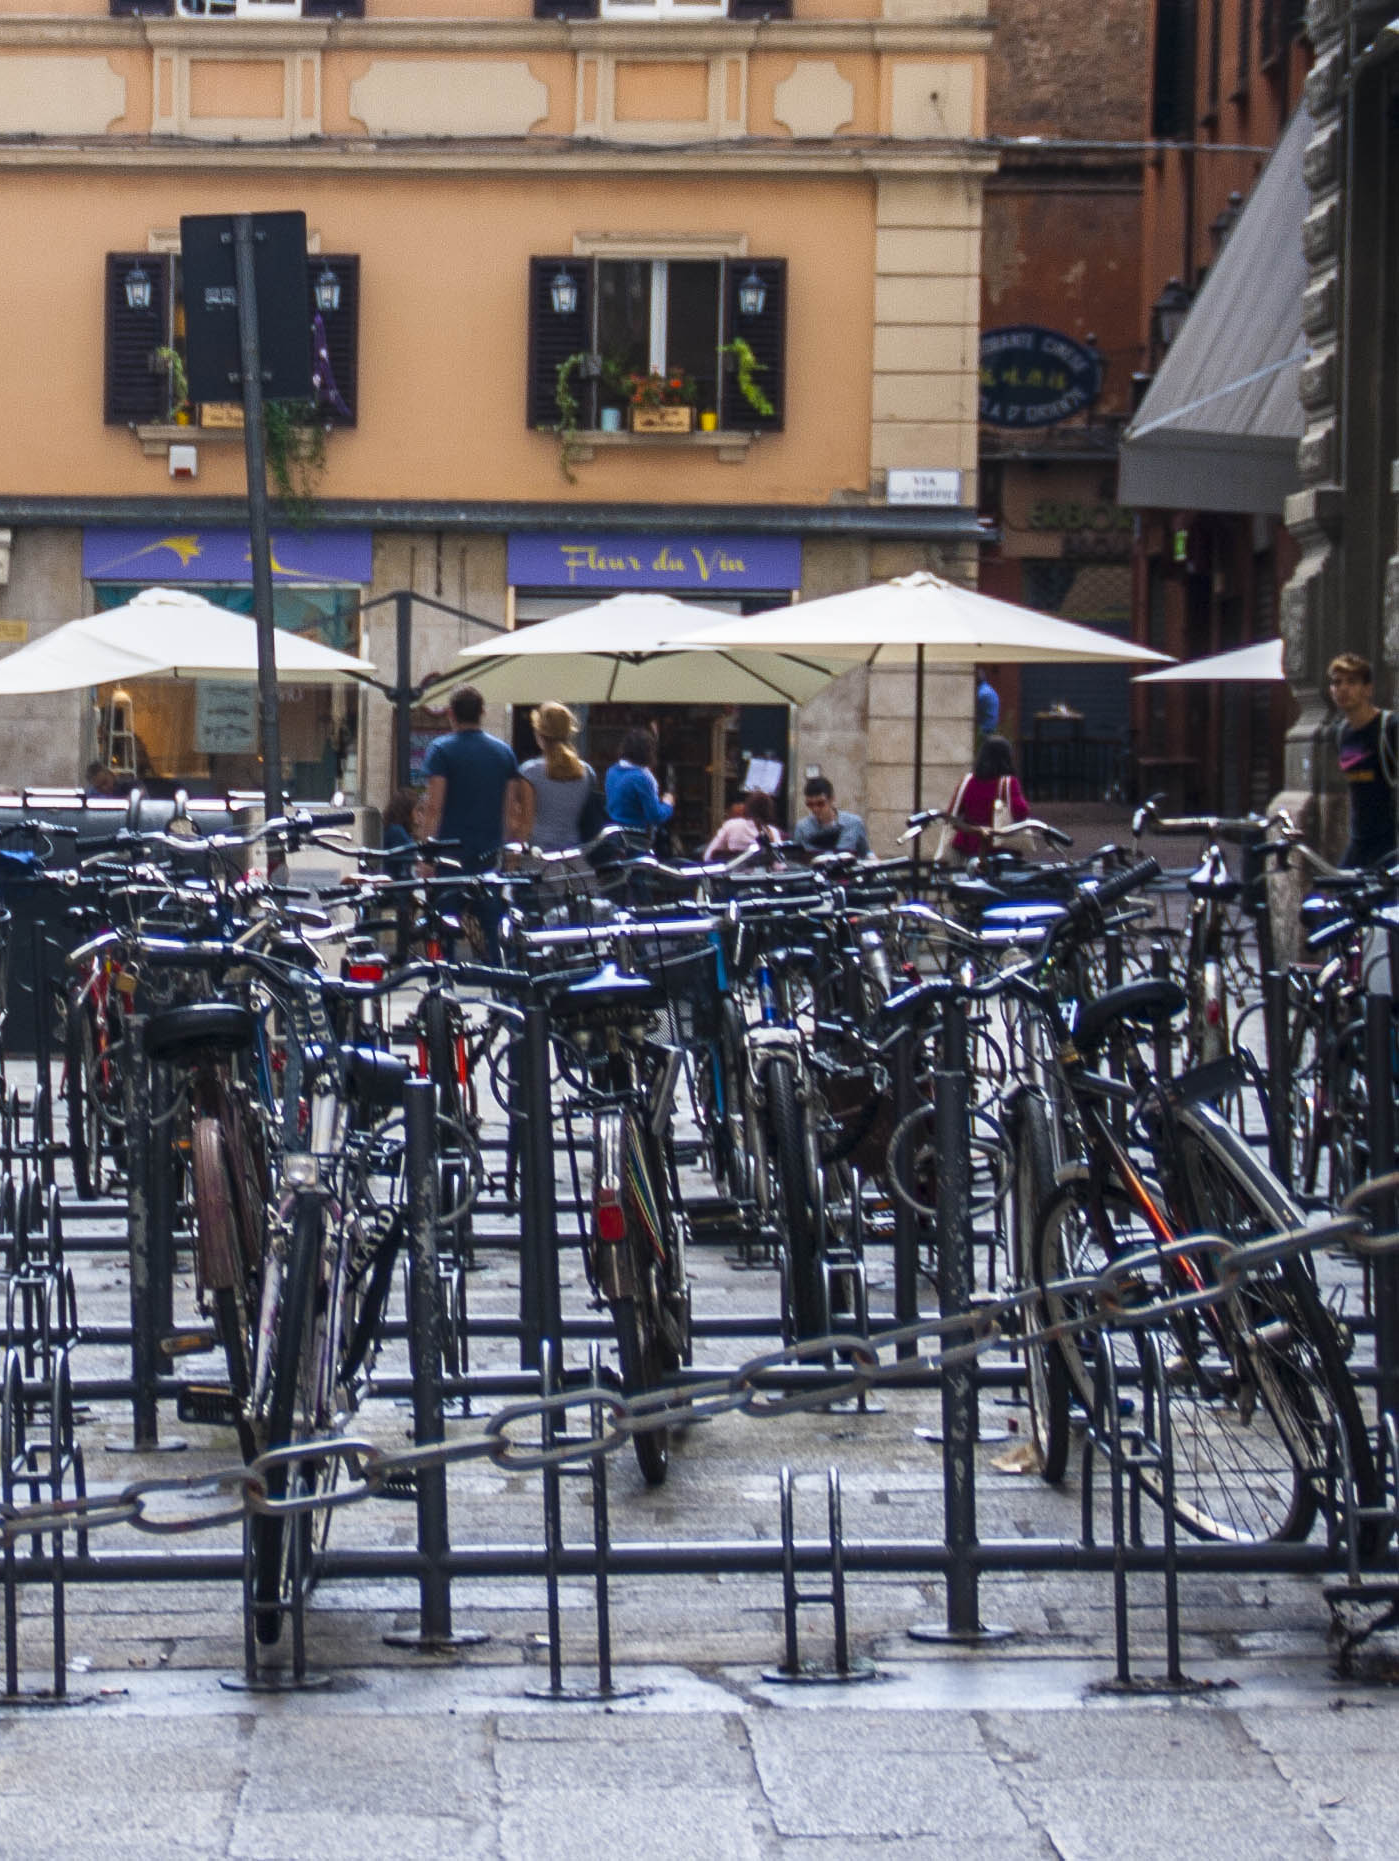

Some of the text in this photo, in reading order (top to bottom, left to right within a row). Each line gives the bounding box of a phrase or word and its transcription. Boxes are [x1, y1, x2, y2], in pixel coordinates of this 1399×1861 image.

[560, 545, 745, 583] Fleur du Vin
